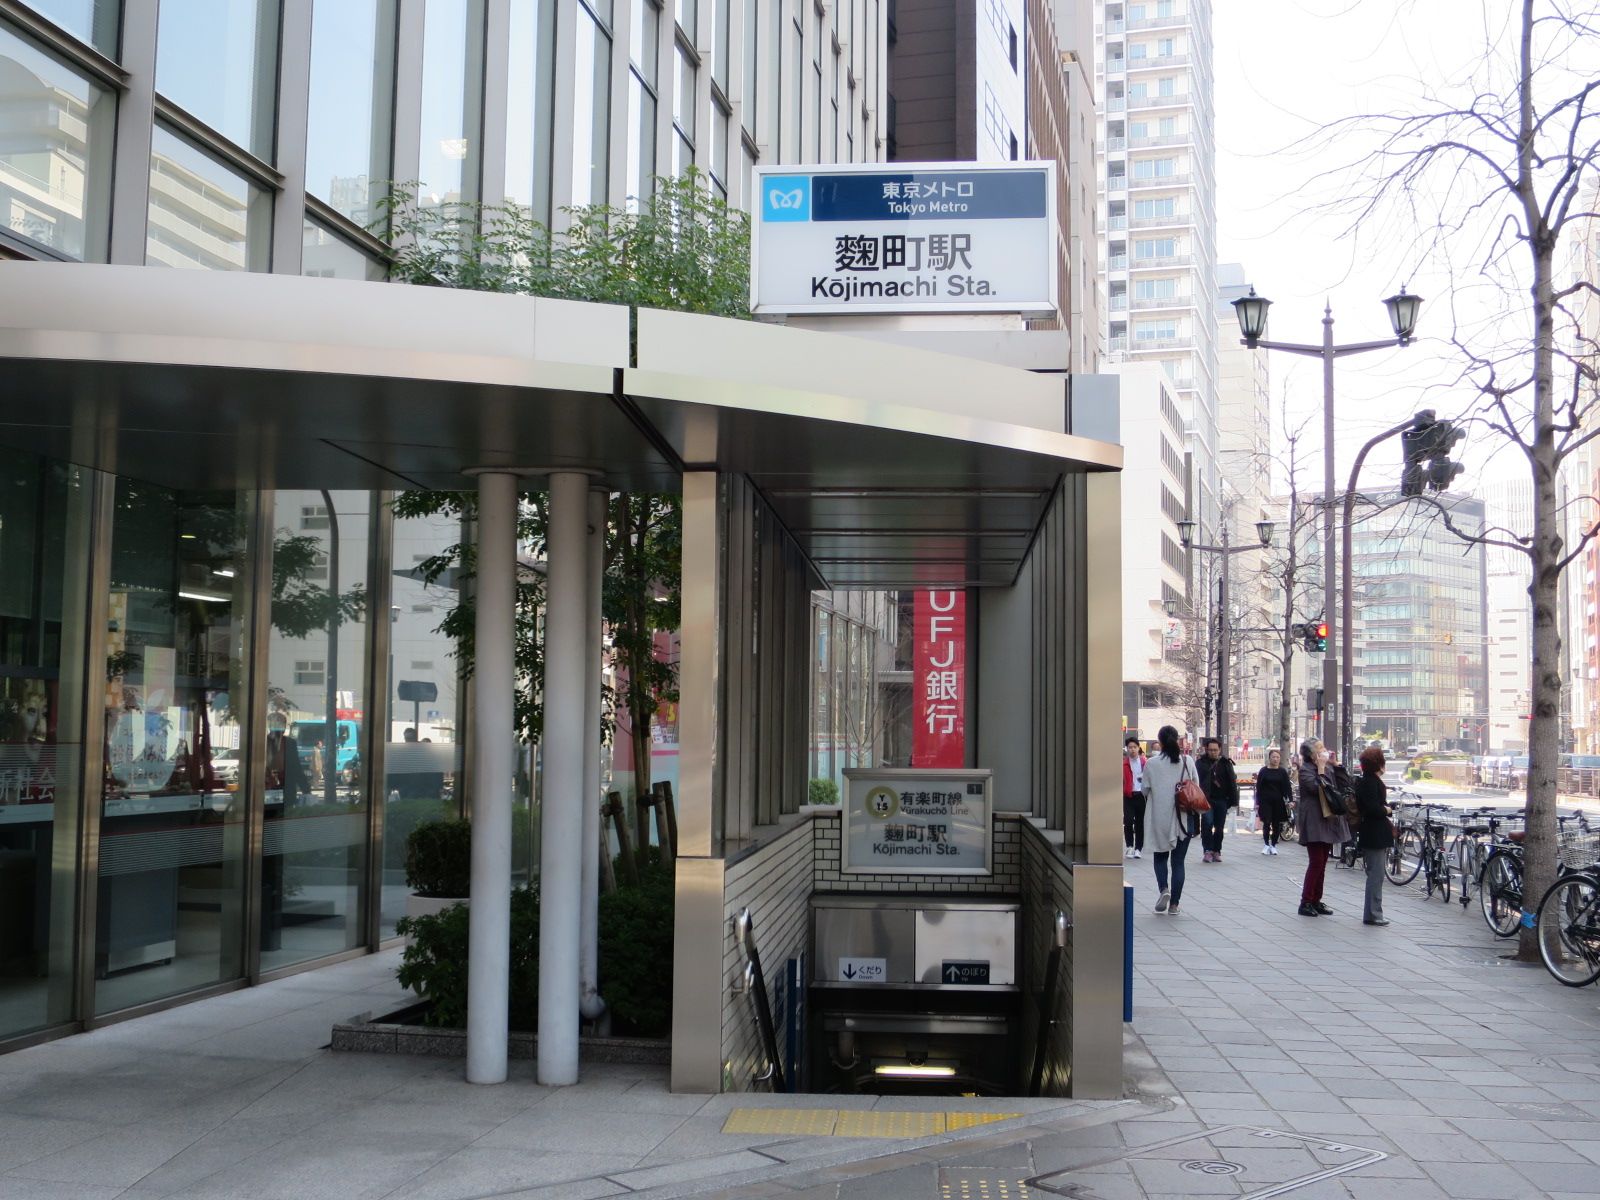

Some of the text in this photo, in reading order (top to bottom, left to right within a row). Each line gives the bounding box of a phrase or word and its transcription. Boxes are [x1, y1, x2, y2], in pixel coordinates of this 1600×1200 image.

[882, 181, 974, 199] 東京メトロ
[888, 201, 968, 214] Tokyo Metro
[811, 274, 997, 302] Kōjimachi Sta.
[926, 591, 957, 734] UFJ銀行
[878, 794, 886, 802] Y
[900, 791, 962, 806] 有楽町線
[876, 803, 889, 811] 15
[950, 806, 969, 816] Line
[873, 843, 961, 856] Kōjimachi Sta.
[858, 965, 882, 975] くだり
[961, 967, 987, 976] のぼり
